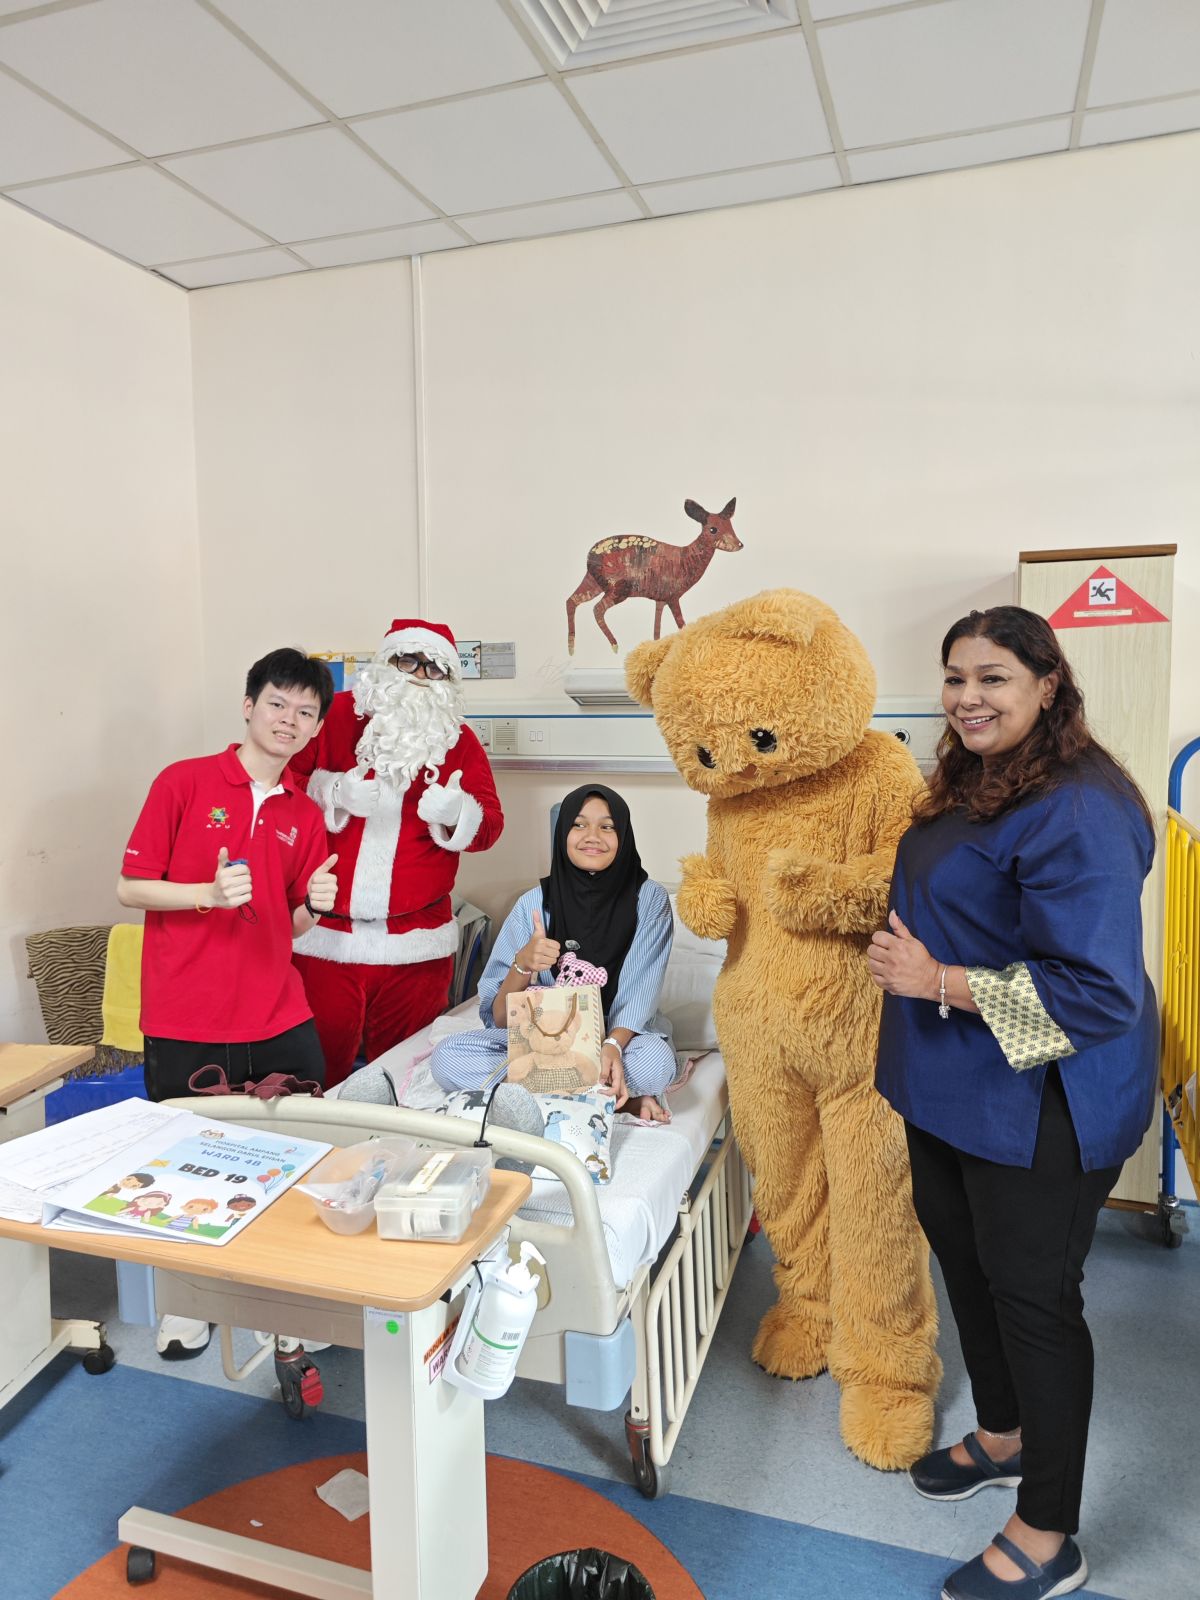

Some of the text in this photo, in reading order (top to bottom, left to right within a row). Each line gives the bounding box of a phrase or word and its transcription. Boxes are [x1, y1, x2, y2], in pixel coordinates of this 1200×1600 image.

[200, 1141, 287, 1164] SELANGOR DARUL EHSAN
[215, 1139, 249, 1150] HOSPITAL
[201, 1149, 262, 1167] WARD 4B
[178, 1163, 248, 1184] BED 19
